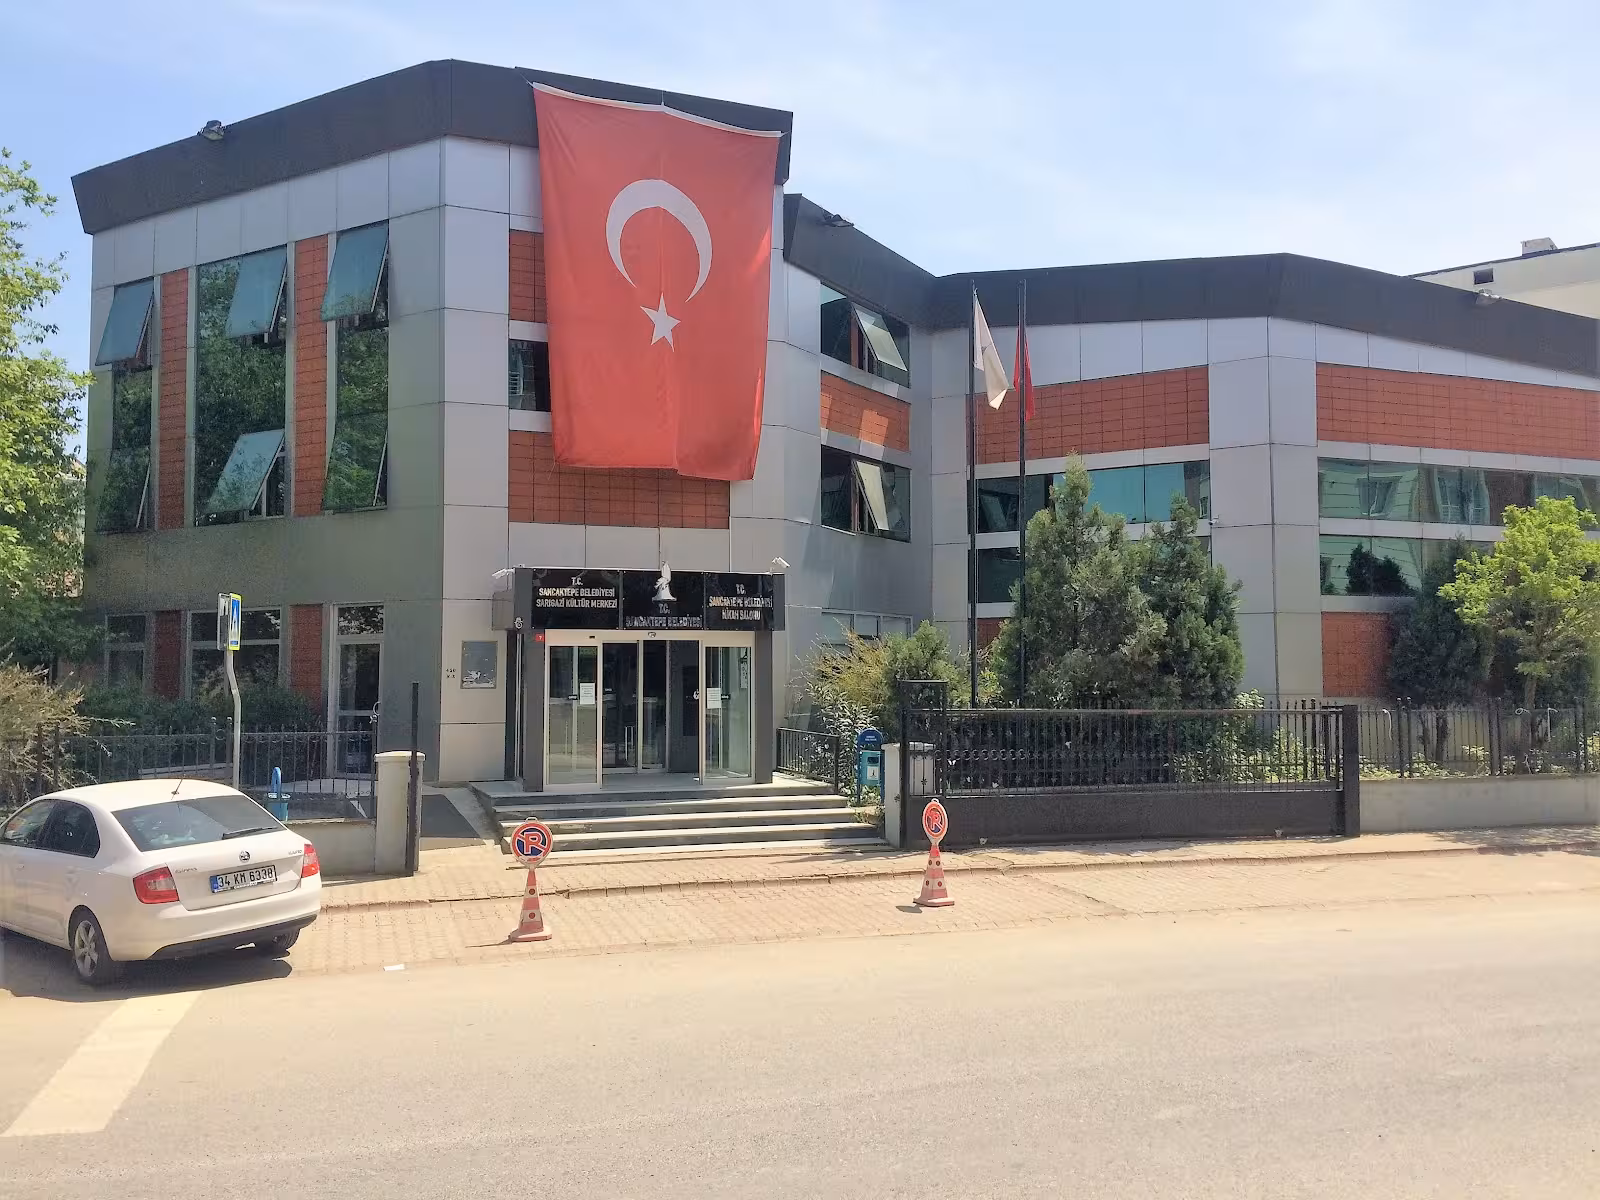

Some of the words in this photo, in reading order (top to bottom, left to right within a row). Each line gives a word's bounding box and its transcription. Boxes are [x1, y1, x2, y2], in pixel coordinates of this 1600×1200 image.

[571, 577, 583, 585] T.C.
[538, 588, 579, 597] SANCAKTEPE
[580, 587, 615, 597] BELEDİYESİ
[536, 598, 565, 607] SARIGAZİ
[566, 598, 590, 608] KÜLTÜR
[591, 599, 618, 608] MERKEZİ
[218, 876, 230, 888] 34
[233, 872, 246, 884] KM
